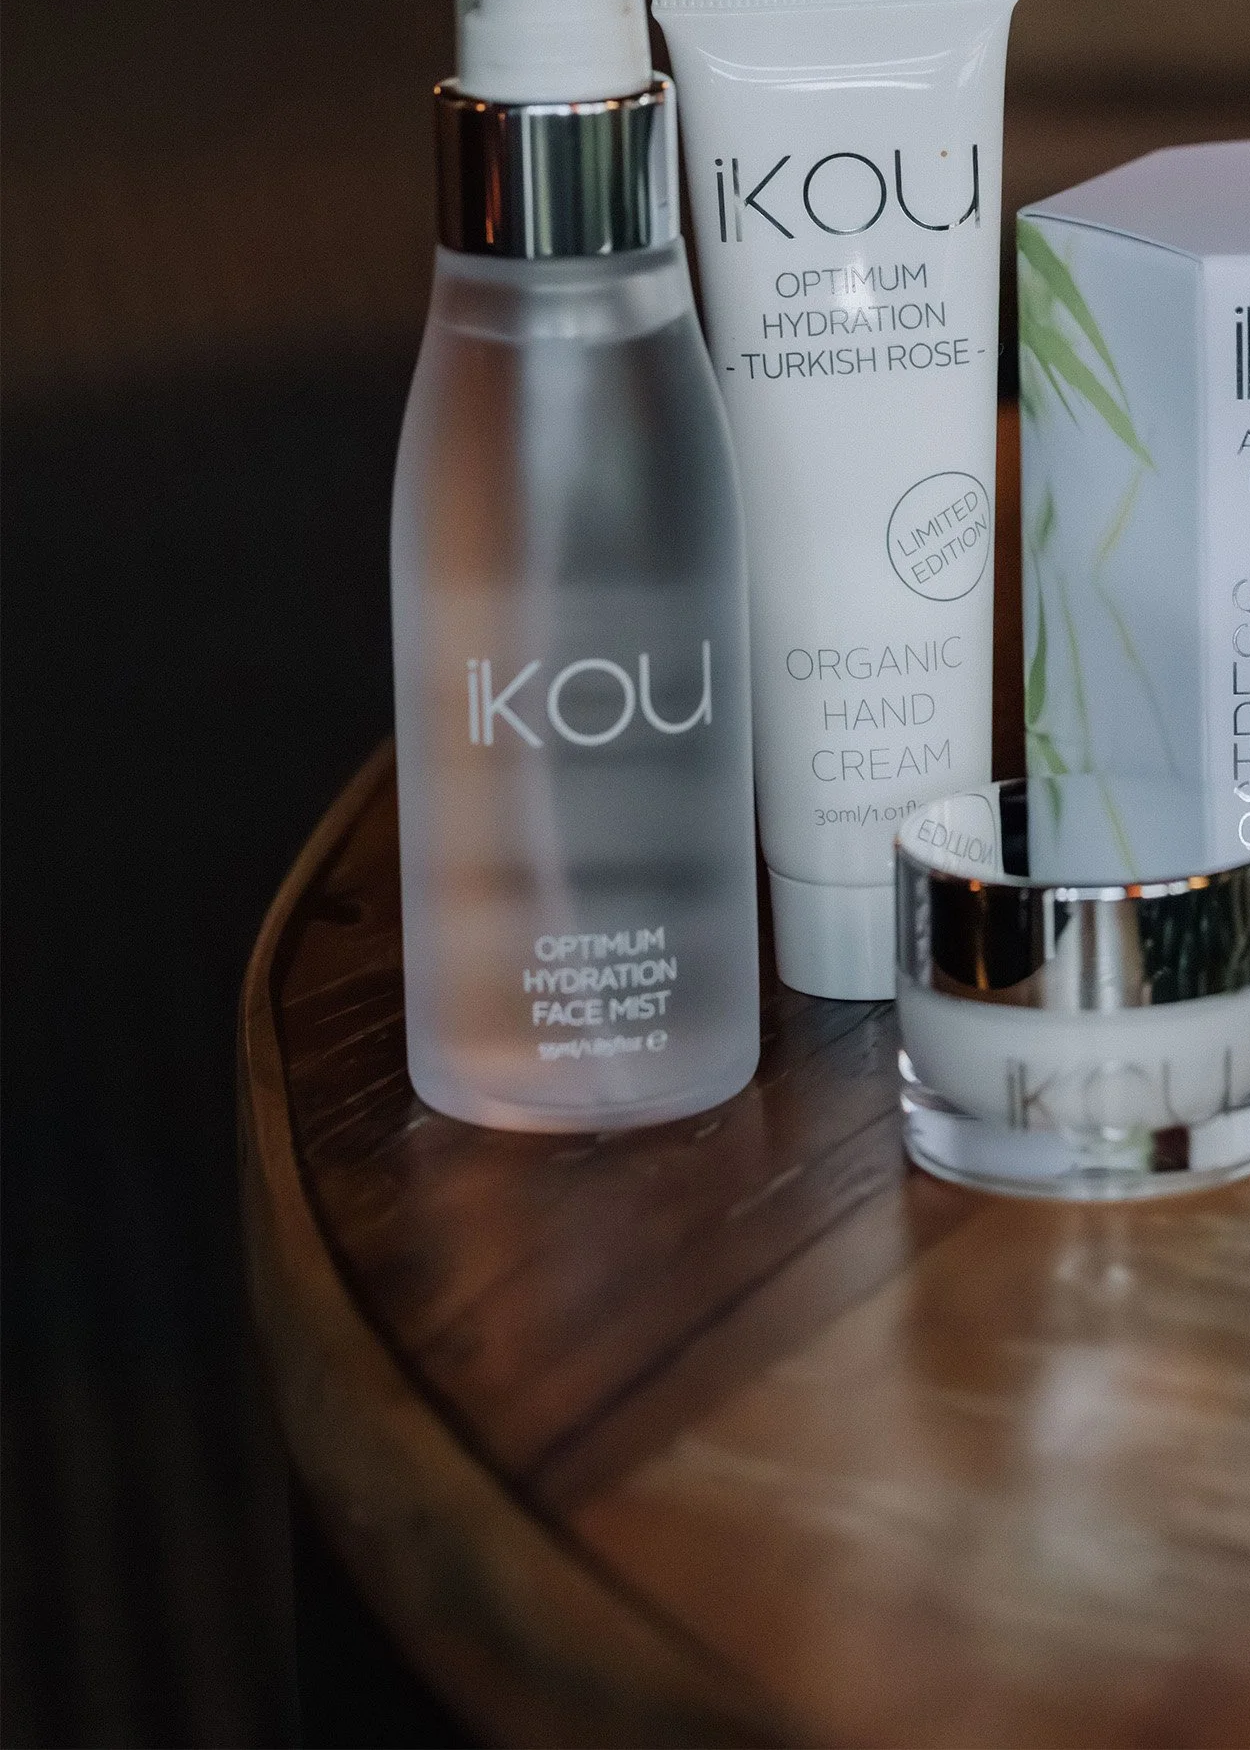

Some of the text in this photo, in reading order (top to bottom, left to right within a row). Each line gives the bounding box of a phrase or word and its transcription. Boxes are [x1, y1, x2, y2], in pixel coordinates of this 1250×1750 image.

[714, 144, 982, 243] iKOU
[775, 263, 928, 298] OPTIMUM
[762, 301, 946, 339] HYDRATION
[741, 347, 877, 379] TURKISH
[887, 338, 970, 371] ROSE
[897, 491, 978, 556] LIMITED
[911, 513, 987, 584] EDITION
[786, 636, 963, 680] ORGANIC
[467, 639, 713, 748] iKOU
[822, 693, 936, 731] HAND
[811, 738, 952, 782] CREAM
[534, 926, 666, 962] OPTIMUM
[522, 955, 678, 994] HYDRATION
[532, 989, 671, 1027] FACE MIST
